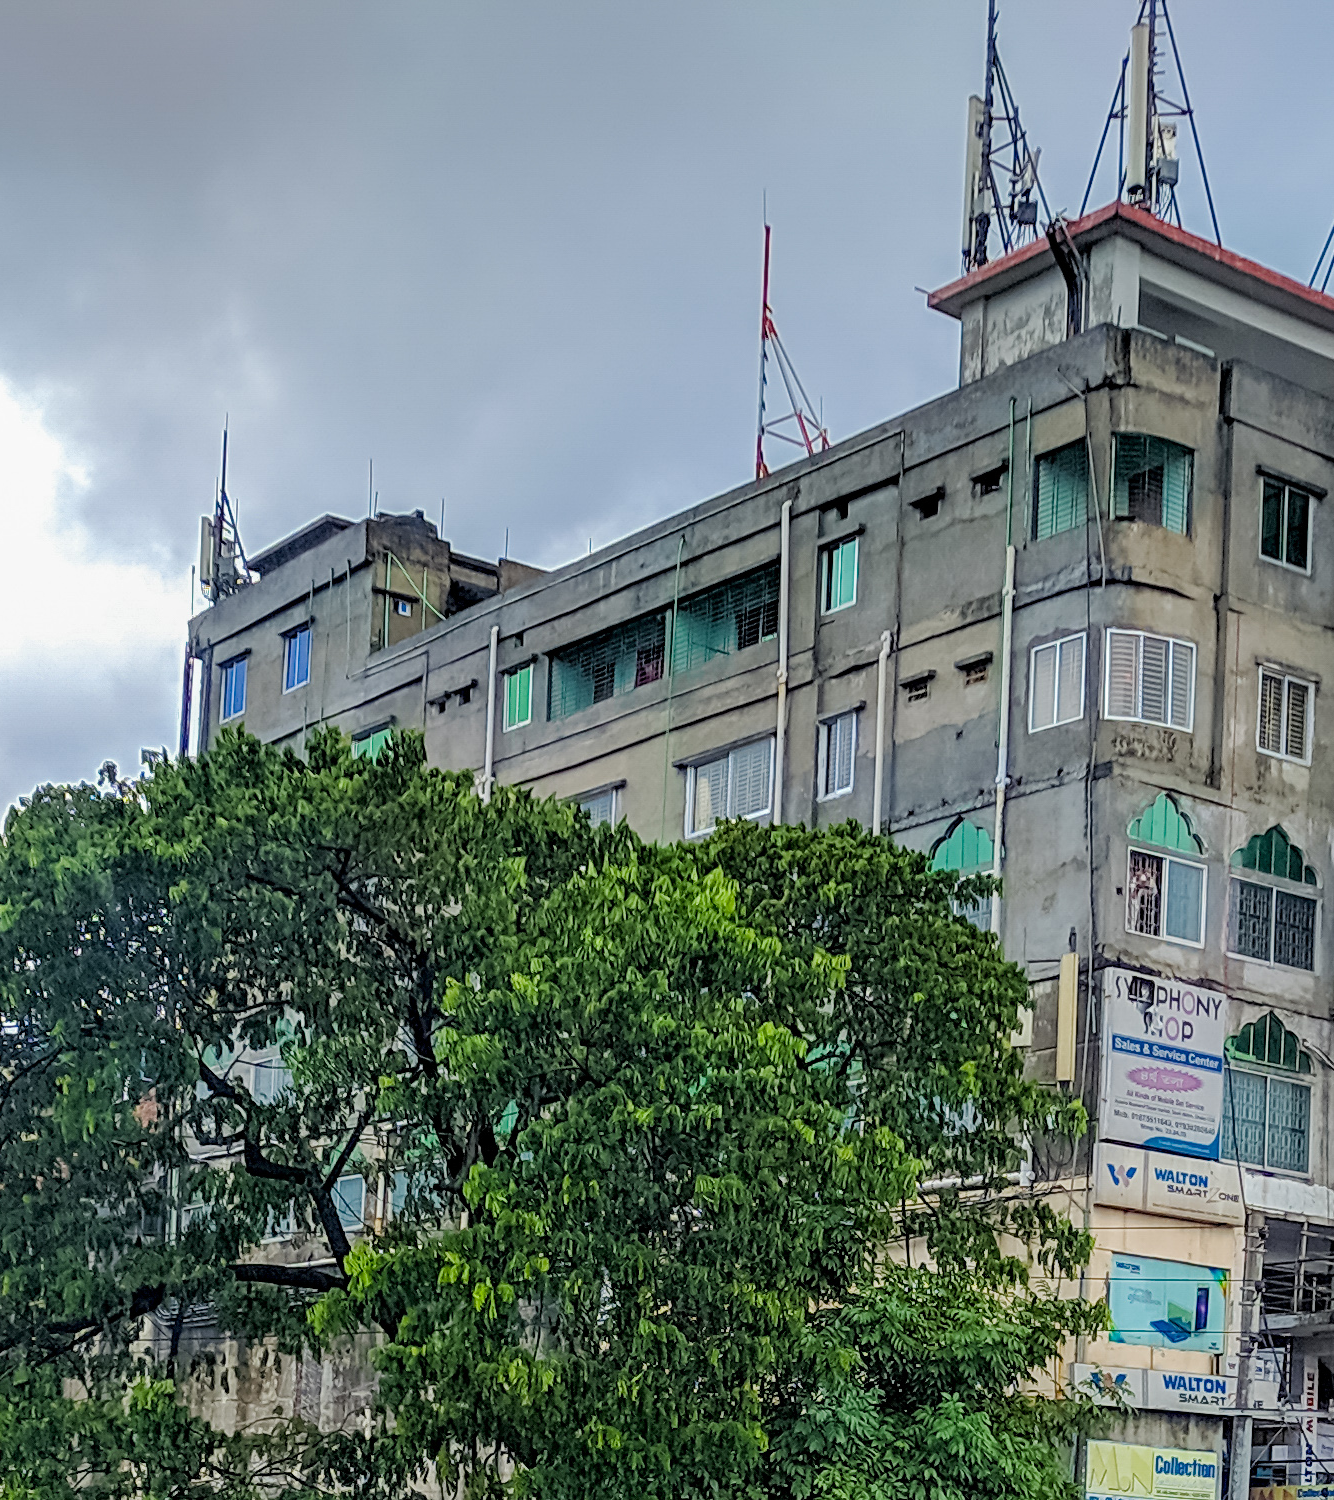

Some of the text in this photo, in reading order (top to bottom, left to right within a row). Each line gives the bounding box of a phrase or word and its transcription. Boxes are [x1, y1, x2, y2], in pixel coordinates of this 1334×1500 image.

[1115, 976, 1223, 1021] SYPHONY
[1114, 1036, 1220, 1069] Sales & Service Center
[1154, 1167, 1209, 1188] WALTON
[1167, 1184, 1209, 1199] SMART
[1162, 1374, 1227, 1394] WALTON
[1178, 1392, 1227, 1406] SMART
[1305, 1372, 1315, 1433] MBILE
[1155, 1455, 1216, 1479] Collection
